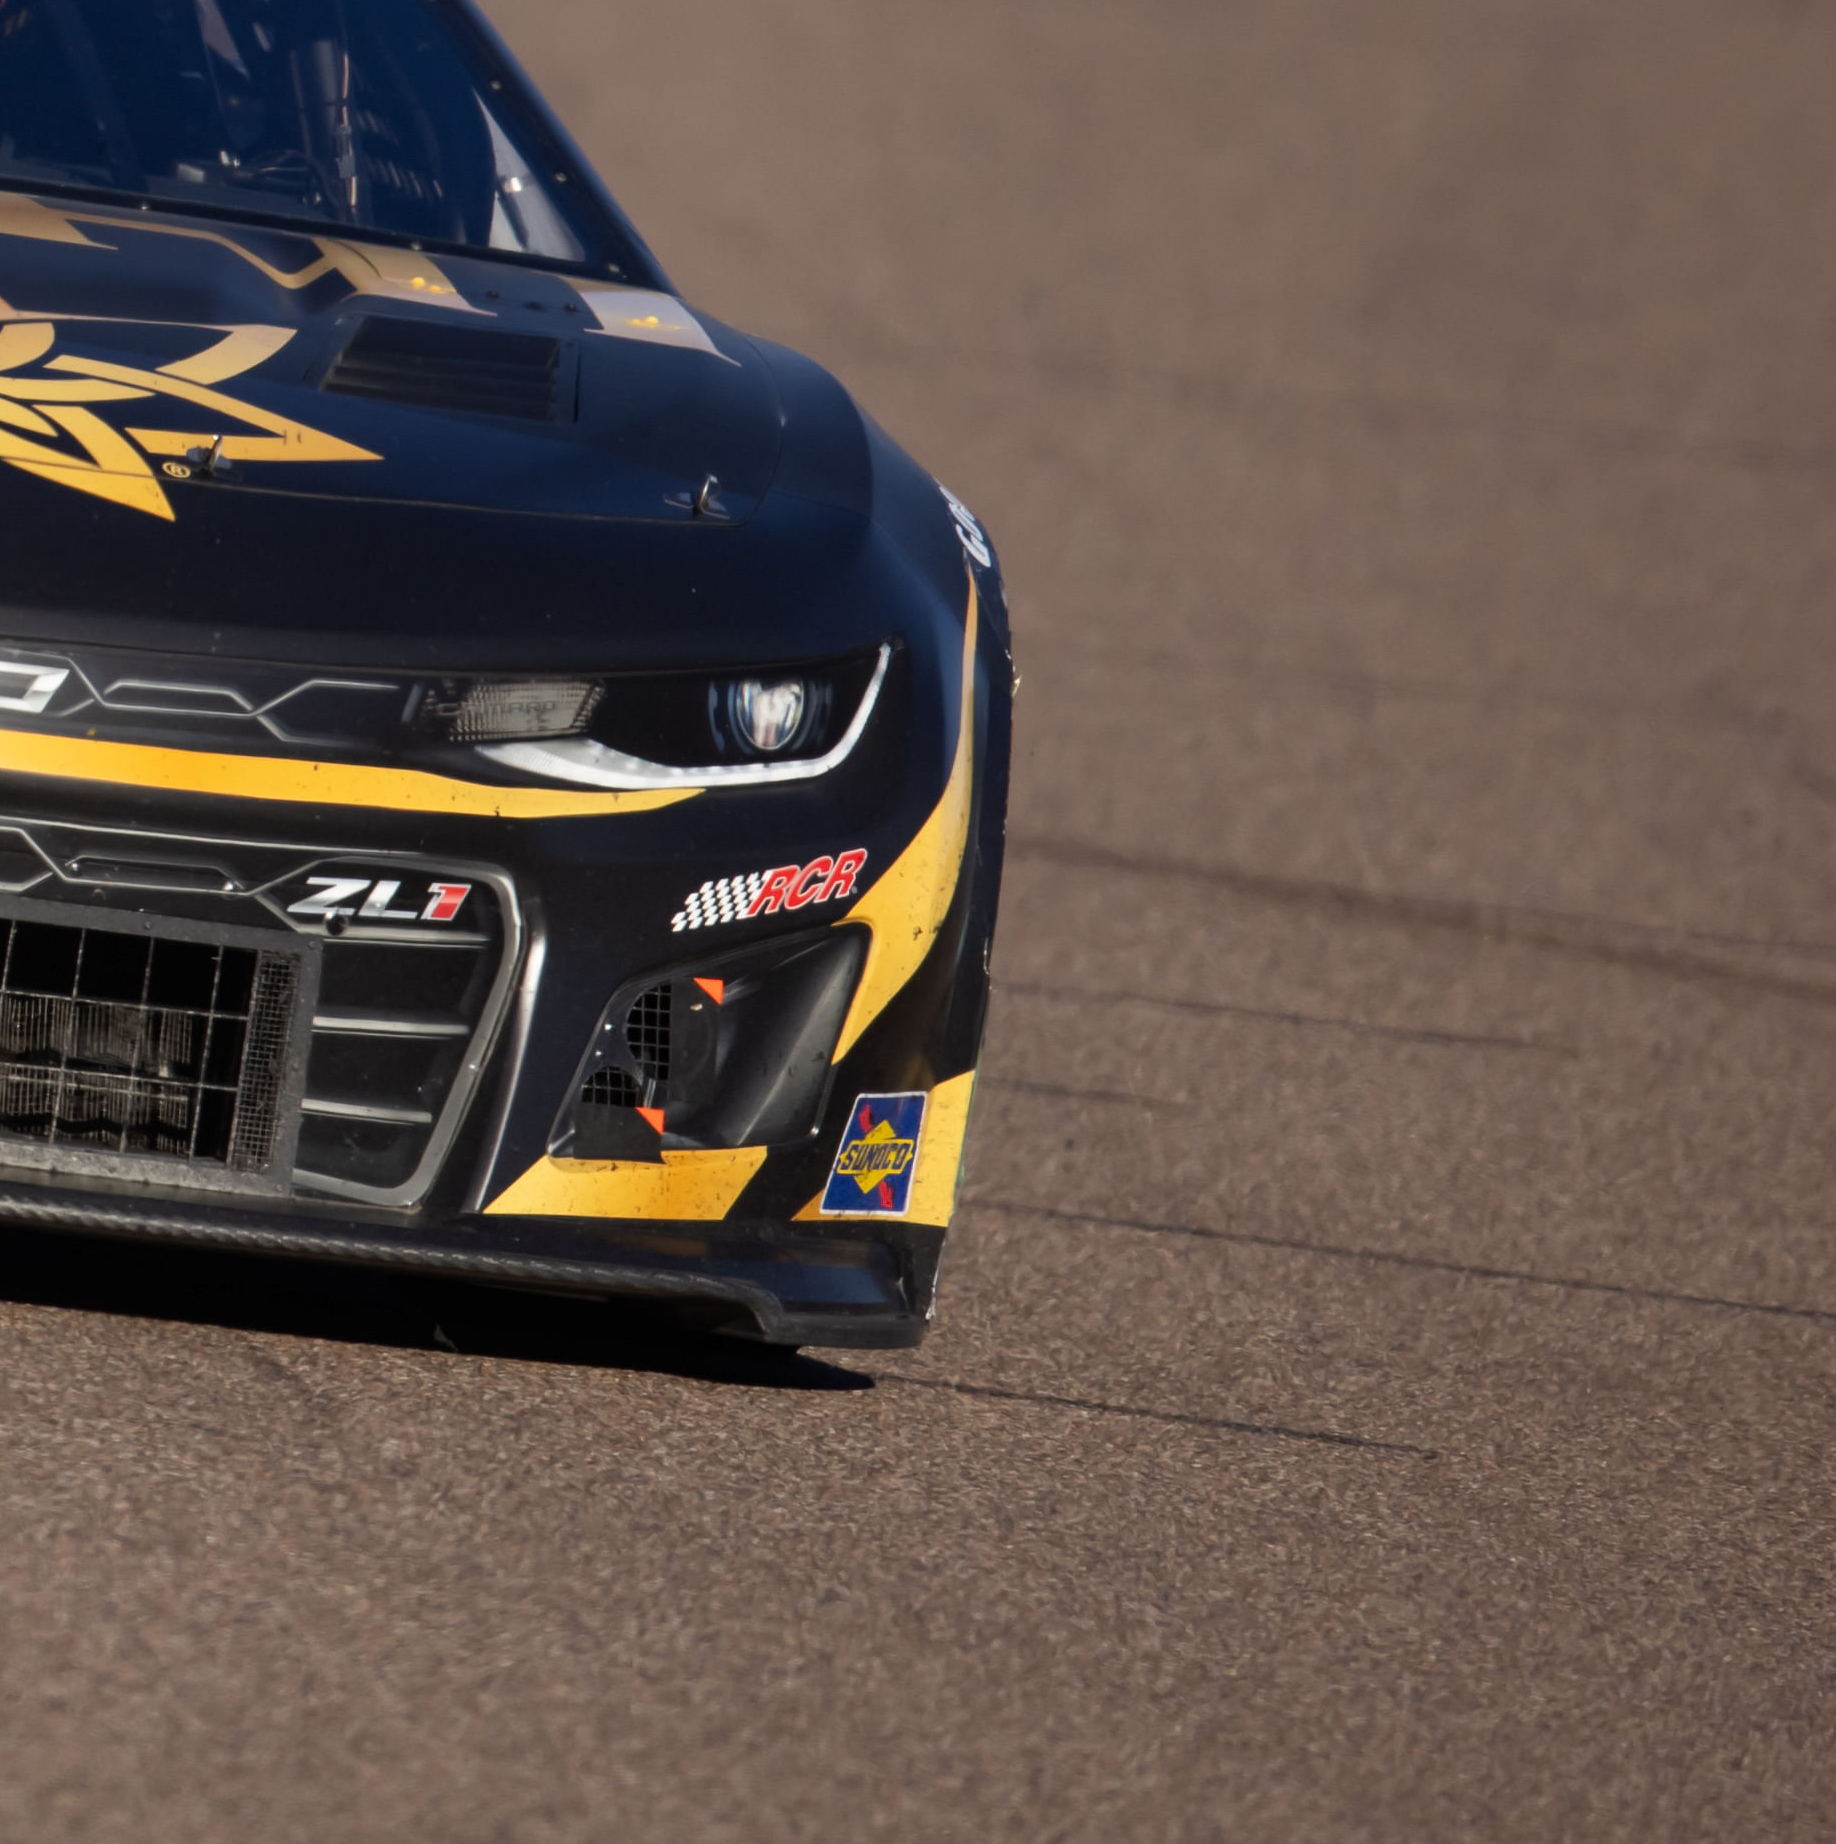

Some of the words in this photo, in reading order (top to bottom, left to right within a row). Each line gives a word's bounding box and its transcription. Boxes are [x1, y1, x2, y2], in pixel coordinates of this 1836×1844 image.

[287, 876, 472, 922] ZL1
[745, 847, 869, 917] RCR
[840, 1141, 909, 1171] SUNOCO
